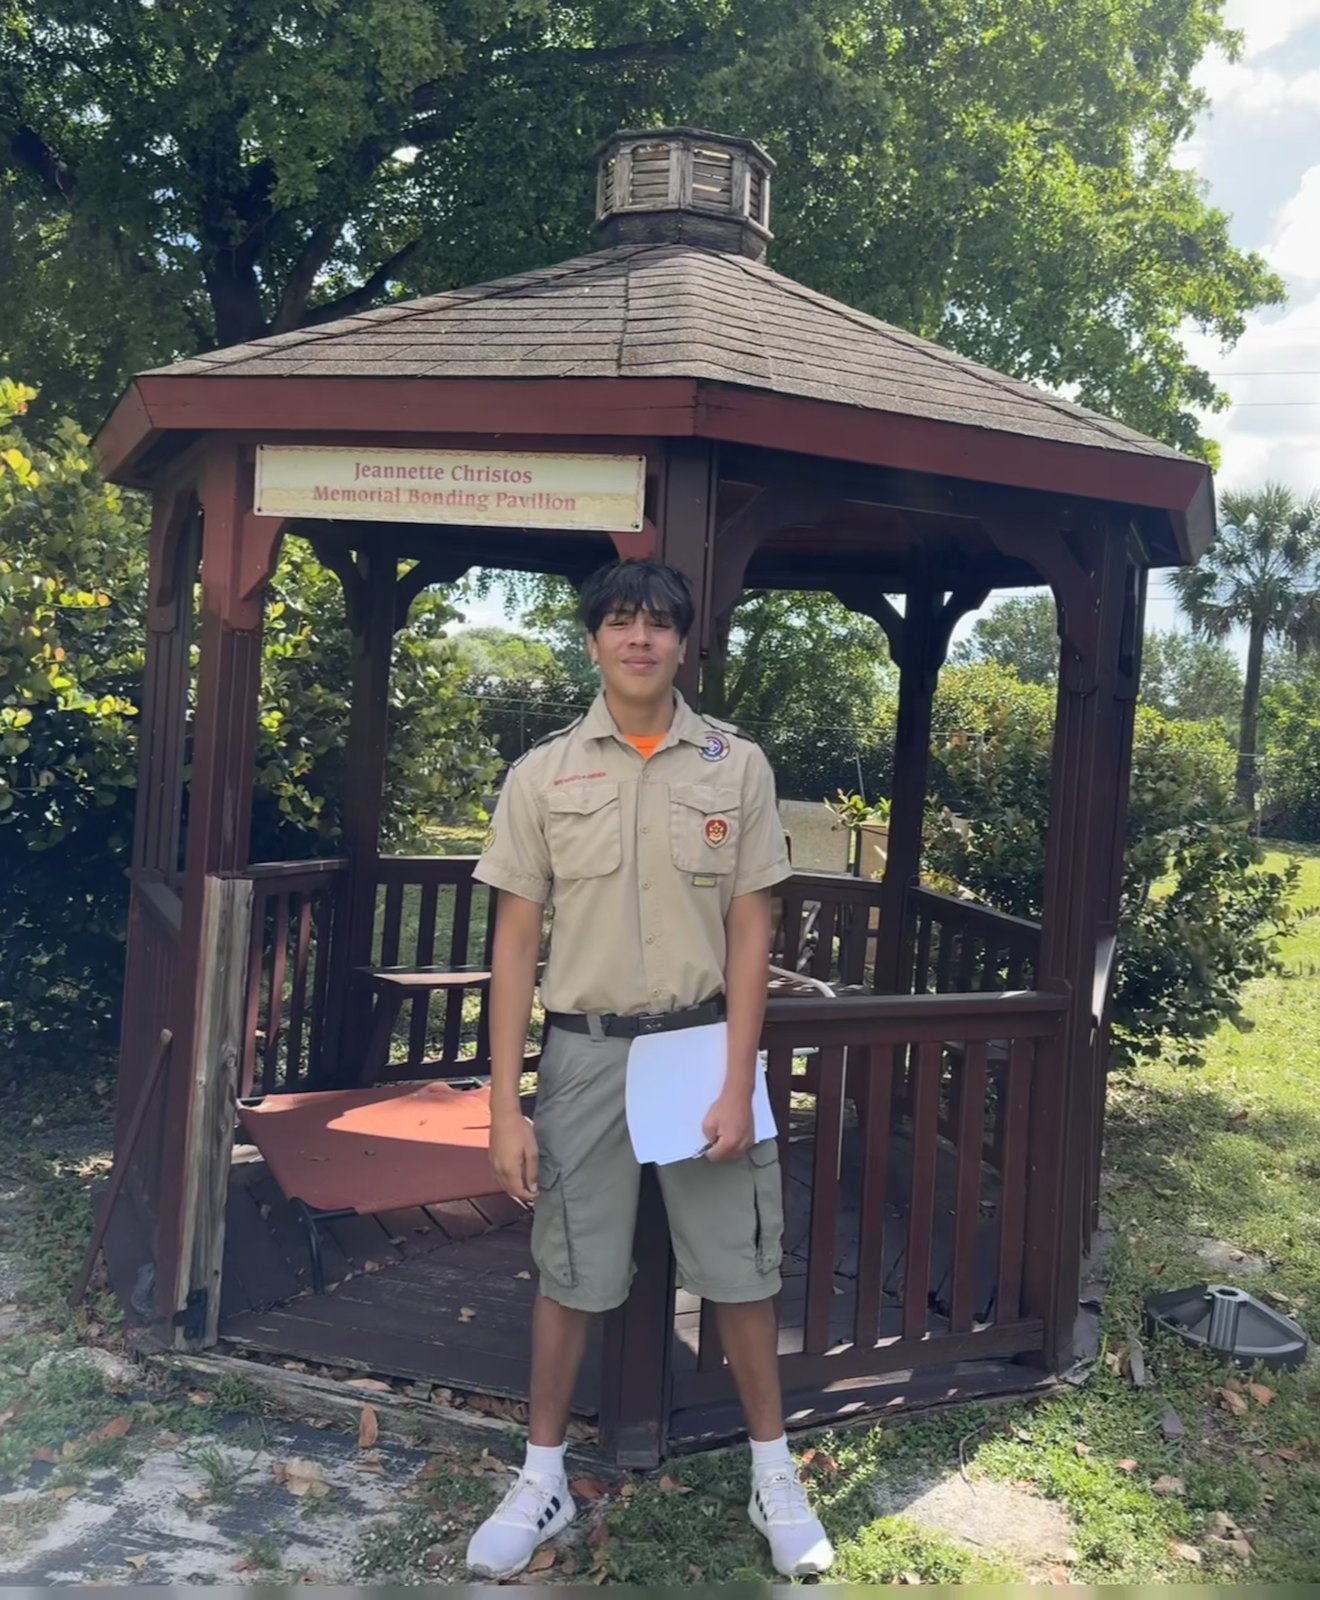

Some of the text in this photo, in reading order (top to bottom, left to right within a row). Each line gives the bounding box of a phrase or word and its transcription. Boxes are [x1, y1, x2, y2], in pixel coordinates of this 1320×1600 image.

[354, 462, 533, 484] Jeannette Christos
[313, 485, 577, 512] Memorial Bonding Pavilion
